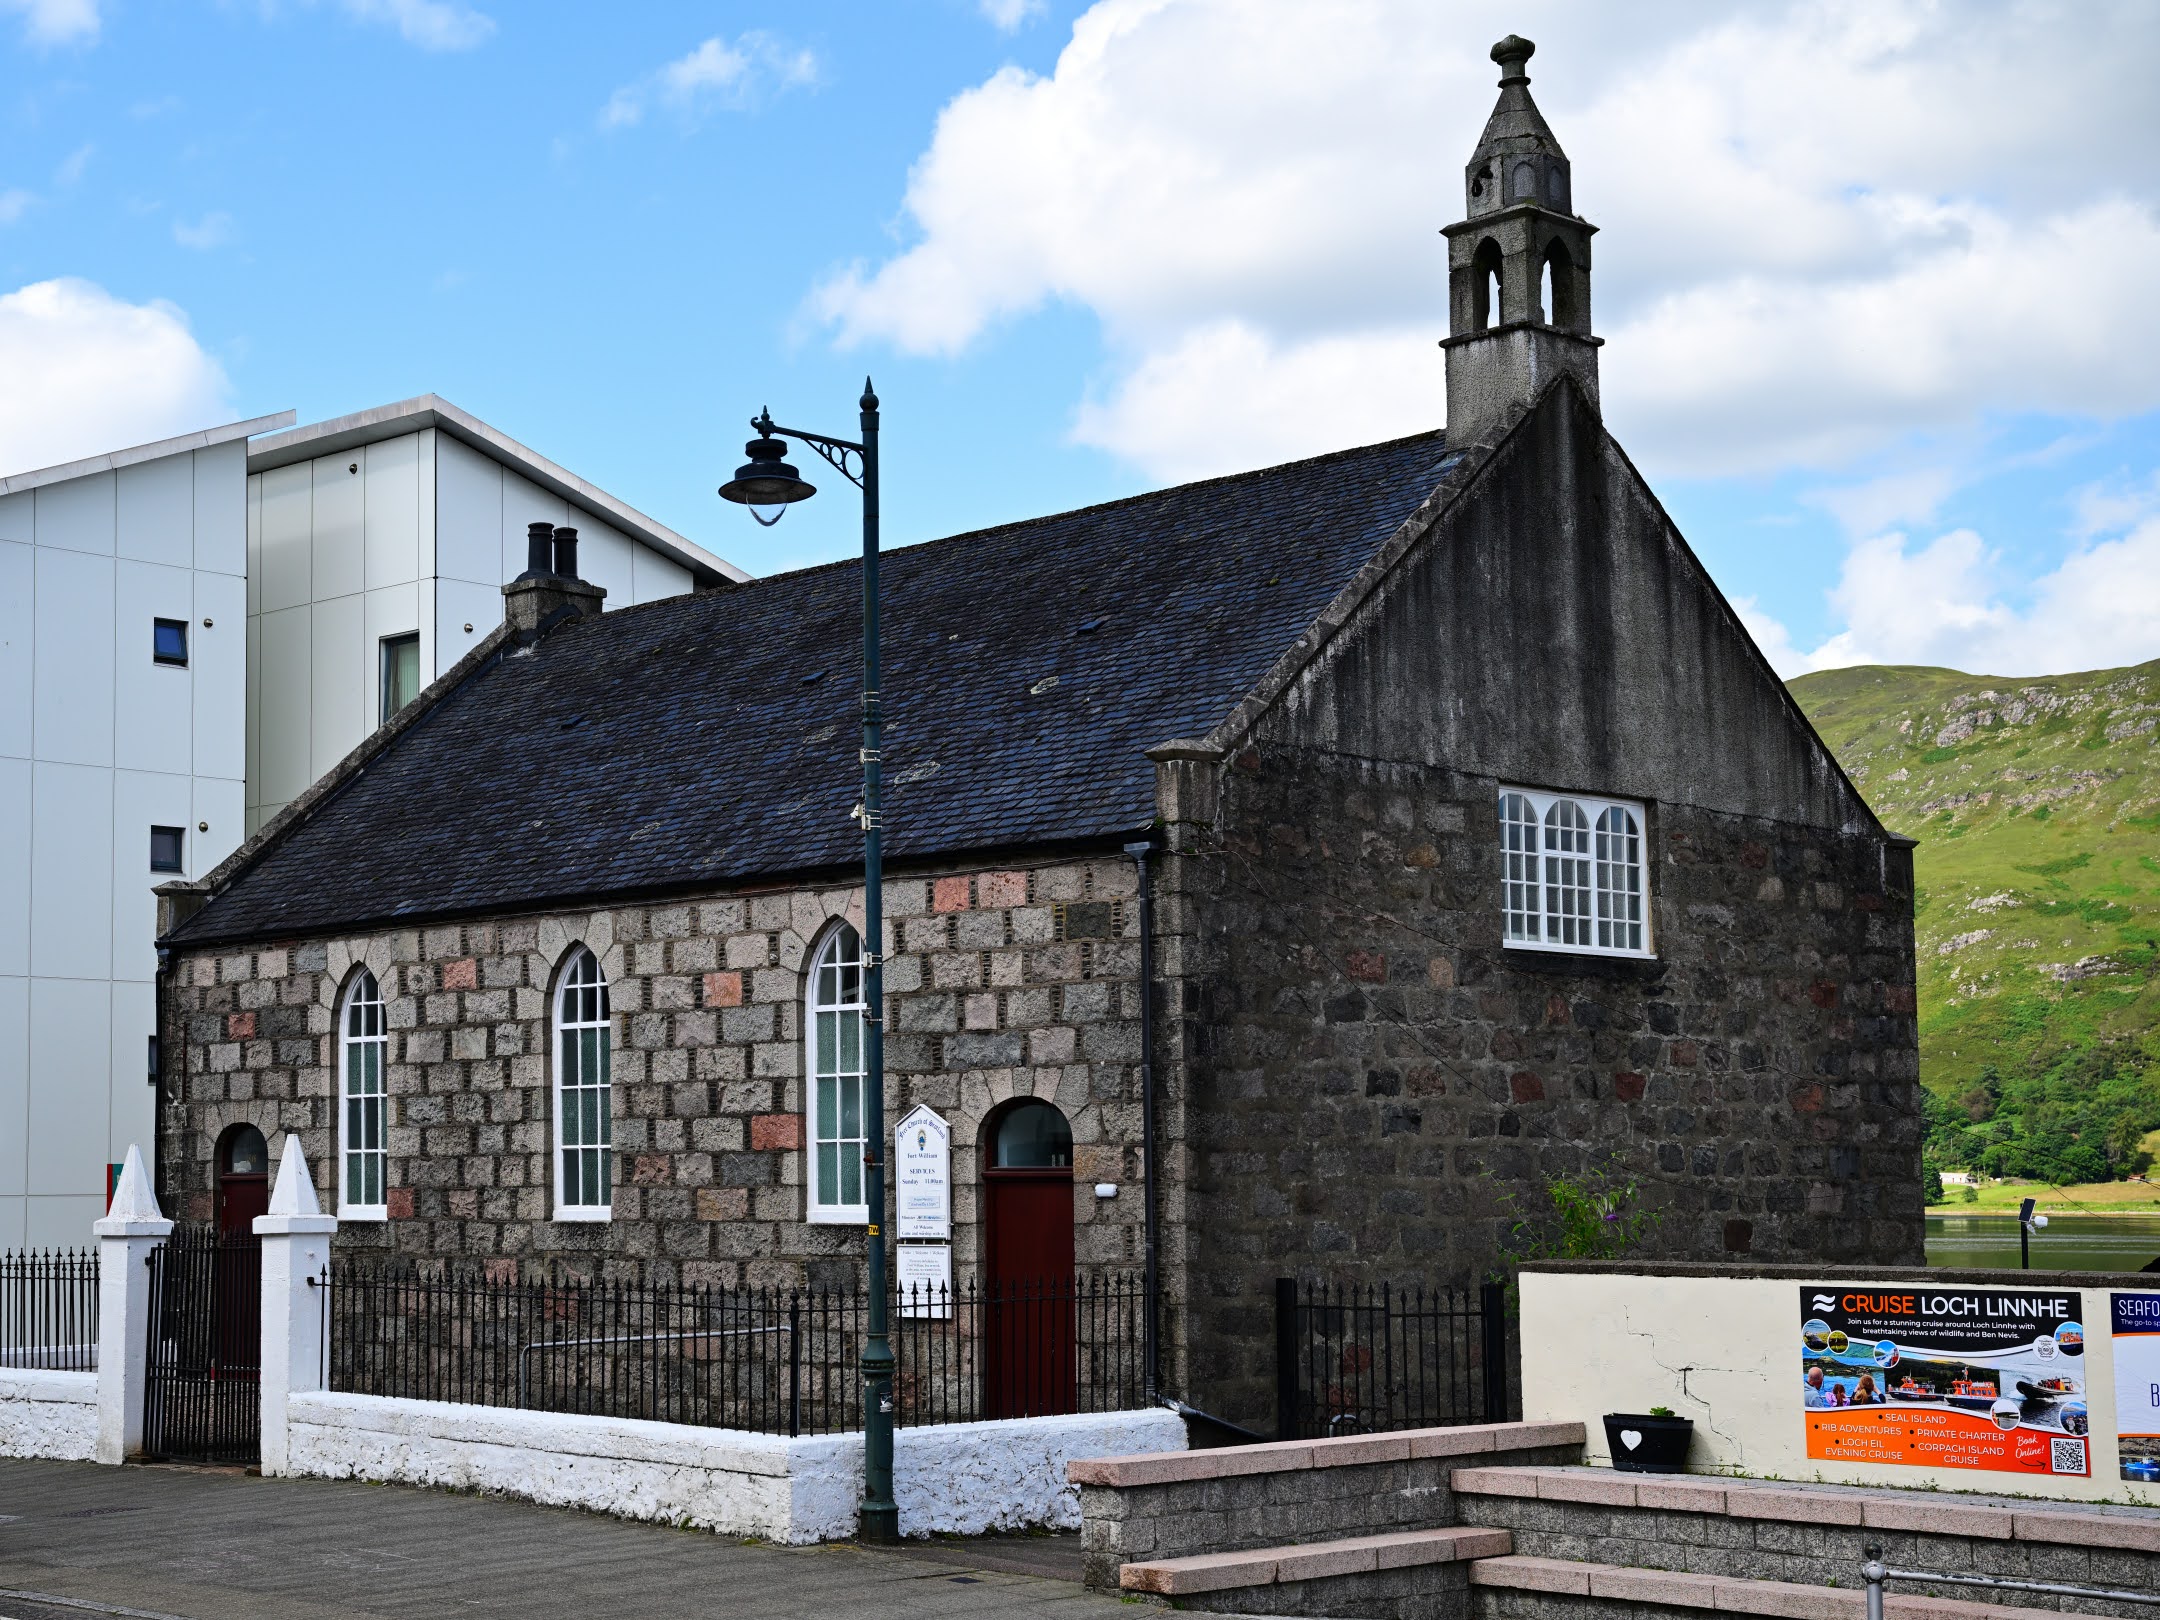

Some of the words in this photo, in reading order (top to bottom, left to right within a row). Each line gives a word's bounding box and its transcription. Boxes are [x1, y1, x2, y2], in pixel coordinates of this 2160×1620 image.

[907, 1120, 923, 1129] Church
[928, 1120, 946, 1140] Scotland
[1842, 1294, 1915, 1314] CRUISE
[1921, 1296, 1979, 1316] LOCH
[1986, 1297, 2069, 1318] LINNHE
[1872, 1318, 1882, 1326] for
[1889, 1319, 1921, 1328] stunning
[1922, 1320, 1944, 1328] cruise
[1945, 1320, 1971, 1329] around
[1972, 1321, 1991, 1329] Loch
[1991, 1322, 2017, 1330] Linnhe
[2018, 1322, 2036, 1331] with
[2134, 1319, 2153, 1327] go-to
[1862, 1327, 1907, 1337] breathtaking
[1938, 1329, 1965, 1338] wildlife
[1965, 1330, 1980, 1339] and
[1981, 1331, 1997, 1339] Ben
[1997, 1331, 2021, 1340] Nevis.
[2150, 1383, 2160, 1407] B
[1885, 1413, 1909, 1422] SEAL
[1911, 1415, 1947, 1424] ISLAND
[1821, 1423, 1837, 1432] RIB
[1839, 1424, 1902, 1436] ADVENTURES
[1917, 1428, 1957, 1439] PRIVATE
[1958, 1430, 2006, 1442] CHARTER
[1842, 1438, 1868, 1447] LOCH
[1870, 1440, 1885, 1448] EIL
[2016, 1434, 2039, 1447] Book
[1825, 1447, 1867, 1458] EVENING
[1868, 1450, 1903, 1460] CRUISE
[1917, 1442, 1966, 1454] CORPACH
[1968, 1446, 2005, 1456] ISLAND
[2015, 1445, 2045, 1459] Online!
[1943, 1455, 1980, 1465] CRUISE
